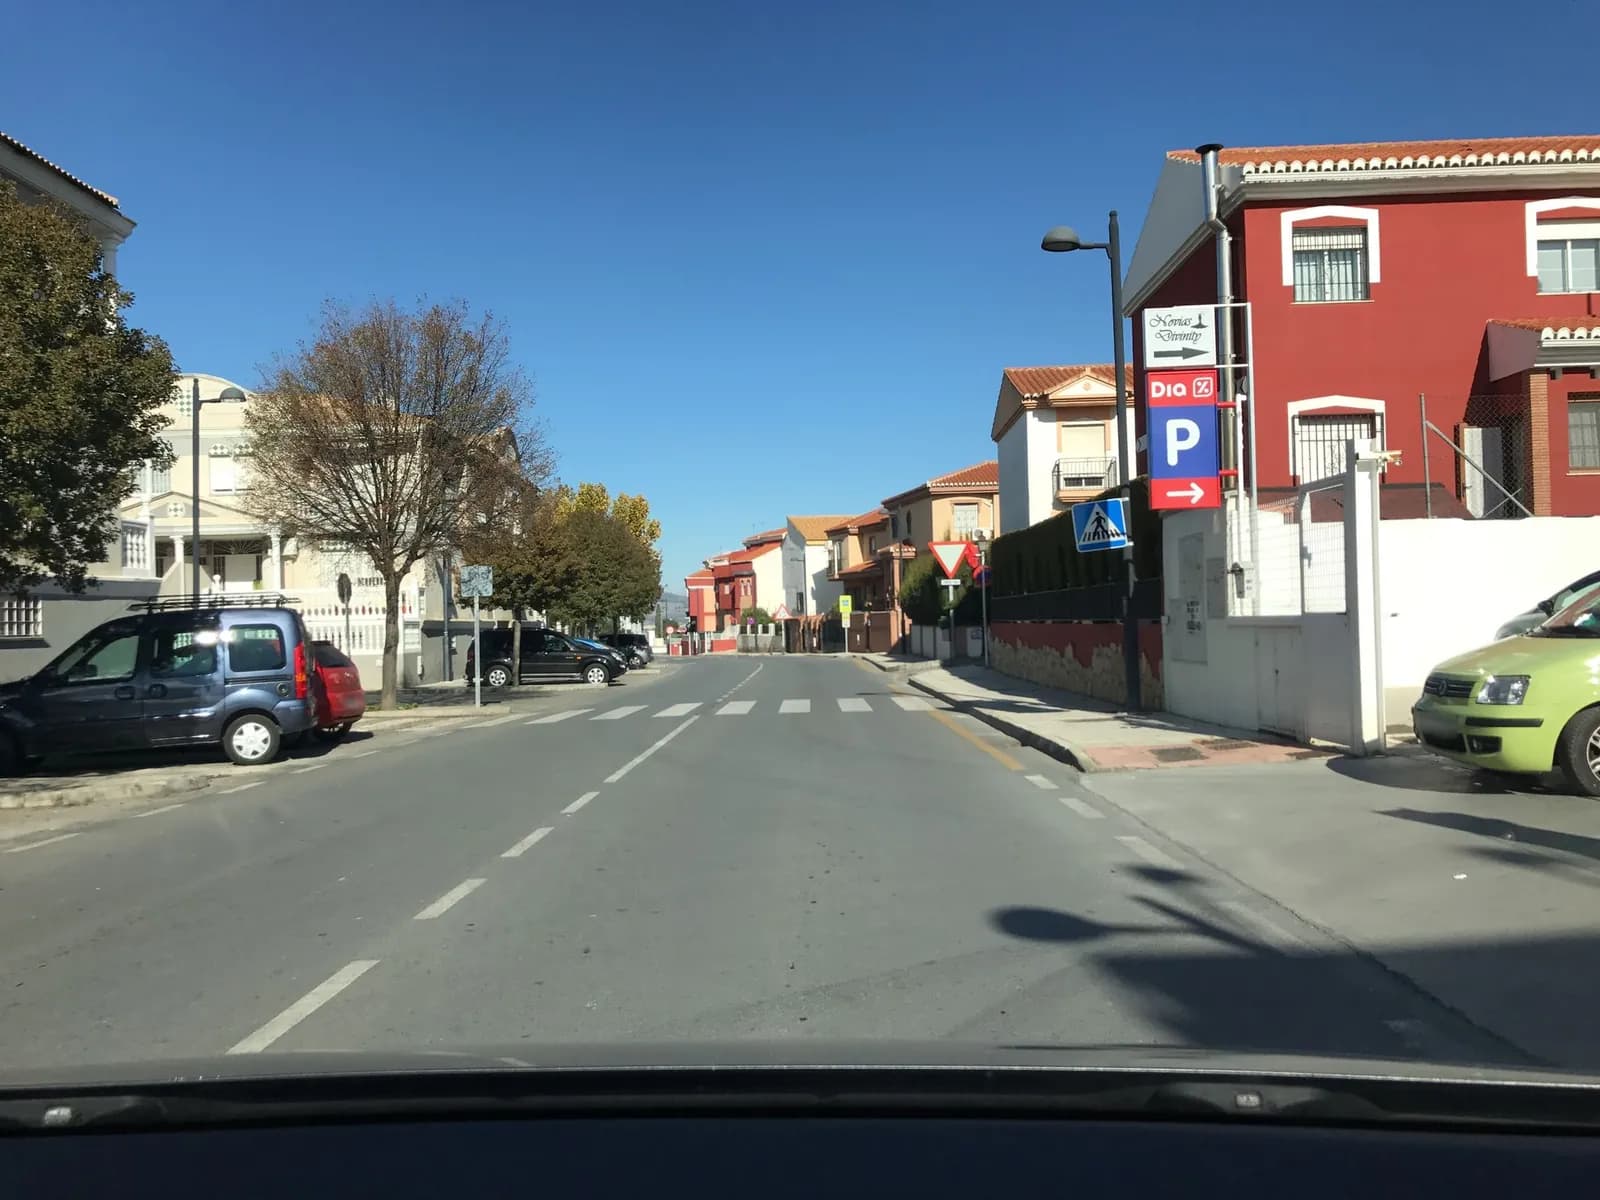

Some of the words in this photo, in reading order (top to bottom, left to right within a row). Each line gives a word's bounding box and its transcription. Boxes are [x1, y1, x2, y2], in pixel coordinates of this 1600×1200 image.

[1149, 314, 1192, 327] Novias
[1155, 330, 1202, 344] Divinity
[1166, 418, 1200, 466] P
